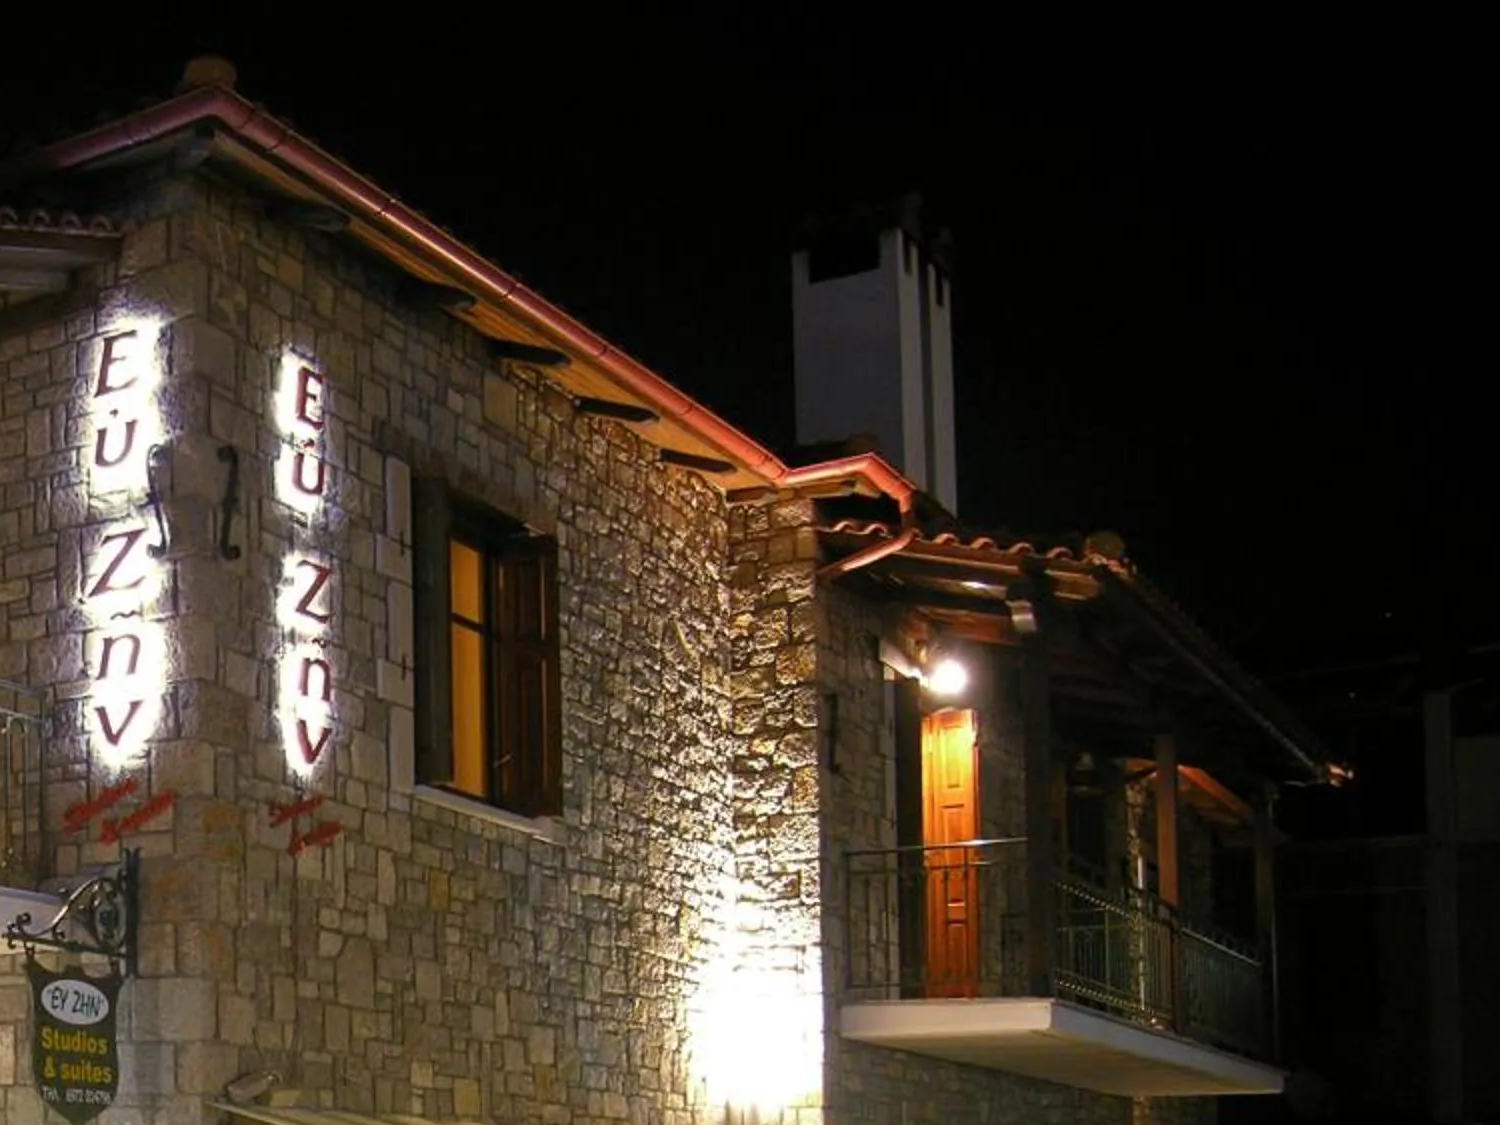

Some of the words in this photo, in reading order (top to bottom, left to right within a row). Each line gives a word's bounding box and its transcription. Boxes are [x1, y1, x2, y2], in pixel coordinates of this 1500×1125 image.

[41, 1027, 109, 1055] Studios
[43, 1056, 56, 1078] &
[60, 1058, 112, 1084] suites
